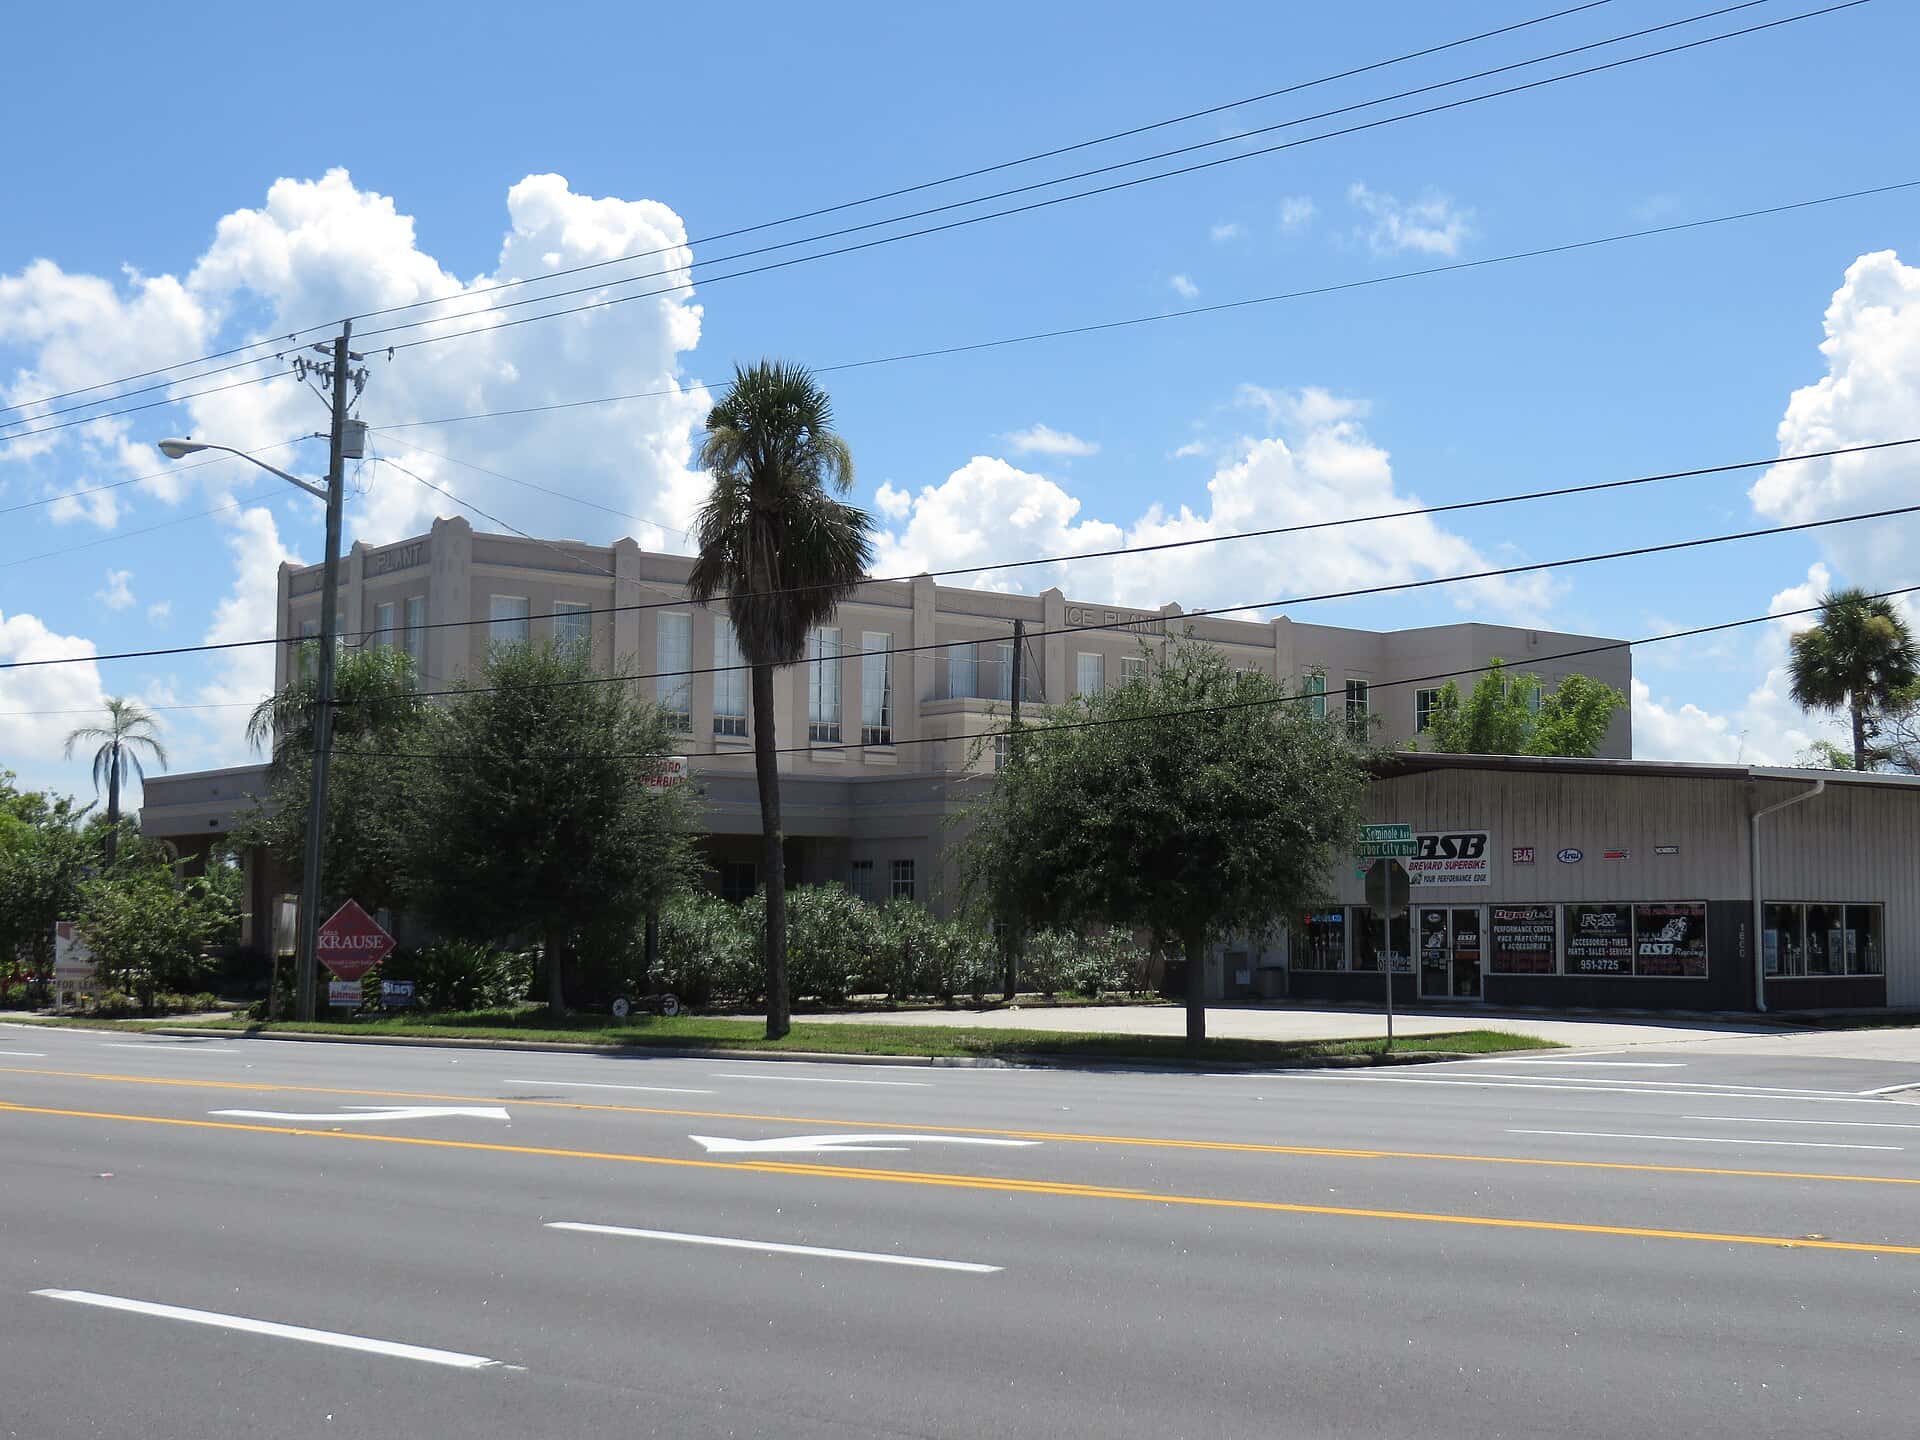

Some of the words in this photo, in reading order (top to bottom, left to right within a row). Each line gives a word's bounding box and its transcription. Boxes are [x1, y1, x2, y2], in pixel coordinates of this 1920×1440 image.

[376, 543, 424, 571] PLANT
[1064, 606, 1096, 626] ICE
[1104, 611, 1160, 633] PLANT
[1366, 827, 1398, 840] Seminole
[1354, 842, 1380, 856] arbor
[1382, 842, 1400, 857] City
[1402, 844, 1417, 855] Blvd
[1411, 834, 1487, 860] BSB
[1559, 849, 1579, 860] Arai
[1408, 860, 1442, 871] BREVARD
[1444, 860, 1486, 870] SUPERBIKE
[1423, 874, 1435, 882] YOUR
[1437, 874, 1472, 882] PERFORMANCE
[1474, 874, 1487, 882] EDGE
[1493, 925, 1532, 933] PERFORMANCE
[1533, 925, 1553, 933] CENTER
[318, 935, 384, 949] KRAUSE
[1571, 938, 1607, 946] ACCESSORIES
[1612, 938, 1628, 946] TIRES
[1567, 947, 1585, 956] PARTS
[1588, 947, 1606, 956] SALES
[1608, 947, 1633, 956] SERVICE
[1639, 943, 1674, 955] BSB
[1580, 959, 1619, 971] 951-2725
[57, 979, 74, 989] FOR
[383, 981, 412, 996] Stacy
